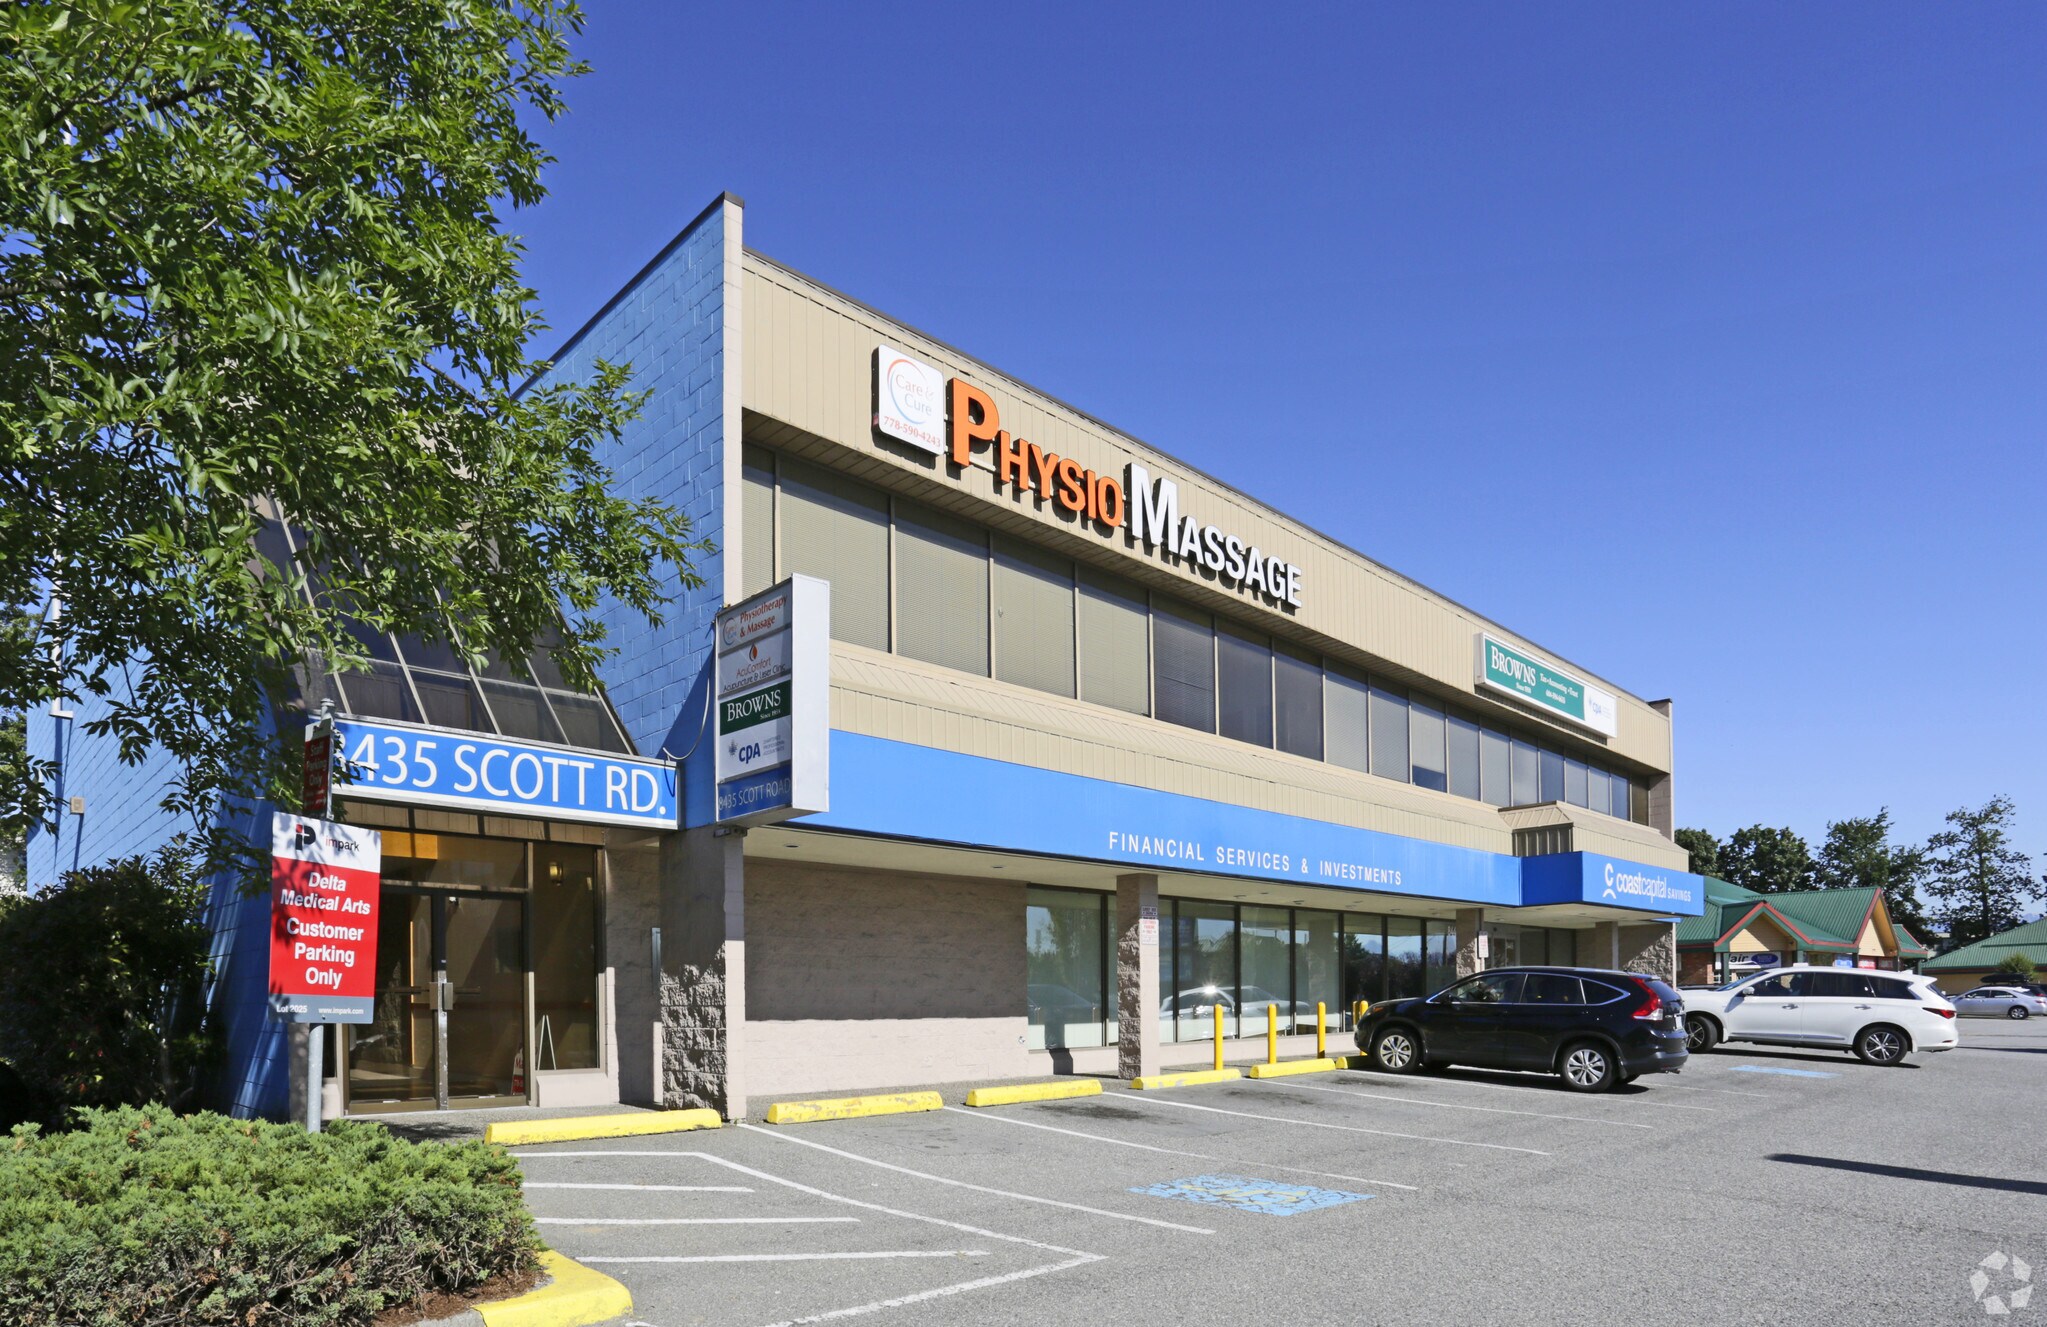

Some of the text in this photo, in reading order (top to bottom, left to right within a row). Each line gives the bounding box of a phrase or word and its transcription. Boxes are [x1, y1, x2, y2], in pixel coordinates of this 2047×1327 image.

[895, 374, 923, 397] Care
[904, 393, 932, 416] Cure
[884, 416, 941, 448] 778-590-4243
[952, 377, 1302, 609] PHYSIO MASSAGE
[740, 595, 788, 623] Physiotherapy
[740, 615, 776, 638] & Massage
[1490, 645, 1537, 687] BROWNS
[727, 689, 782, 722] BROWNS
[453, 744, 595, 806] SCOTT
[605, 765, 667, 815] RD.
[738, 784, 765, 806] SCOTT
[766, 777, 791, 798] ROAD
[326, 836, 359, 852] impark
[1109, 831, 1402, 886] FINANCIAL SERVICES & INVESTMENTS
[308, 872, 347, 892] Delta
[280, 889, 371, 915] Medical Arts
[1667, 888, 1692, 903] SAVINGS
[286, 917, 364, 941] Customer
[294, 942, 355, 968] Parking
[305, 966, 343, 990] Only
[276, 1004, 308, 1013] Lot 2025
[318, 1007, 364, 1016] www.impark.com
